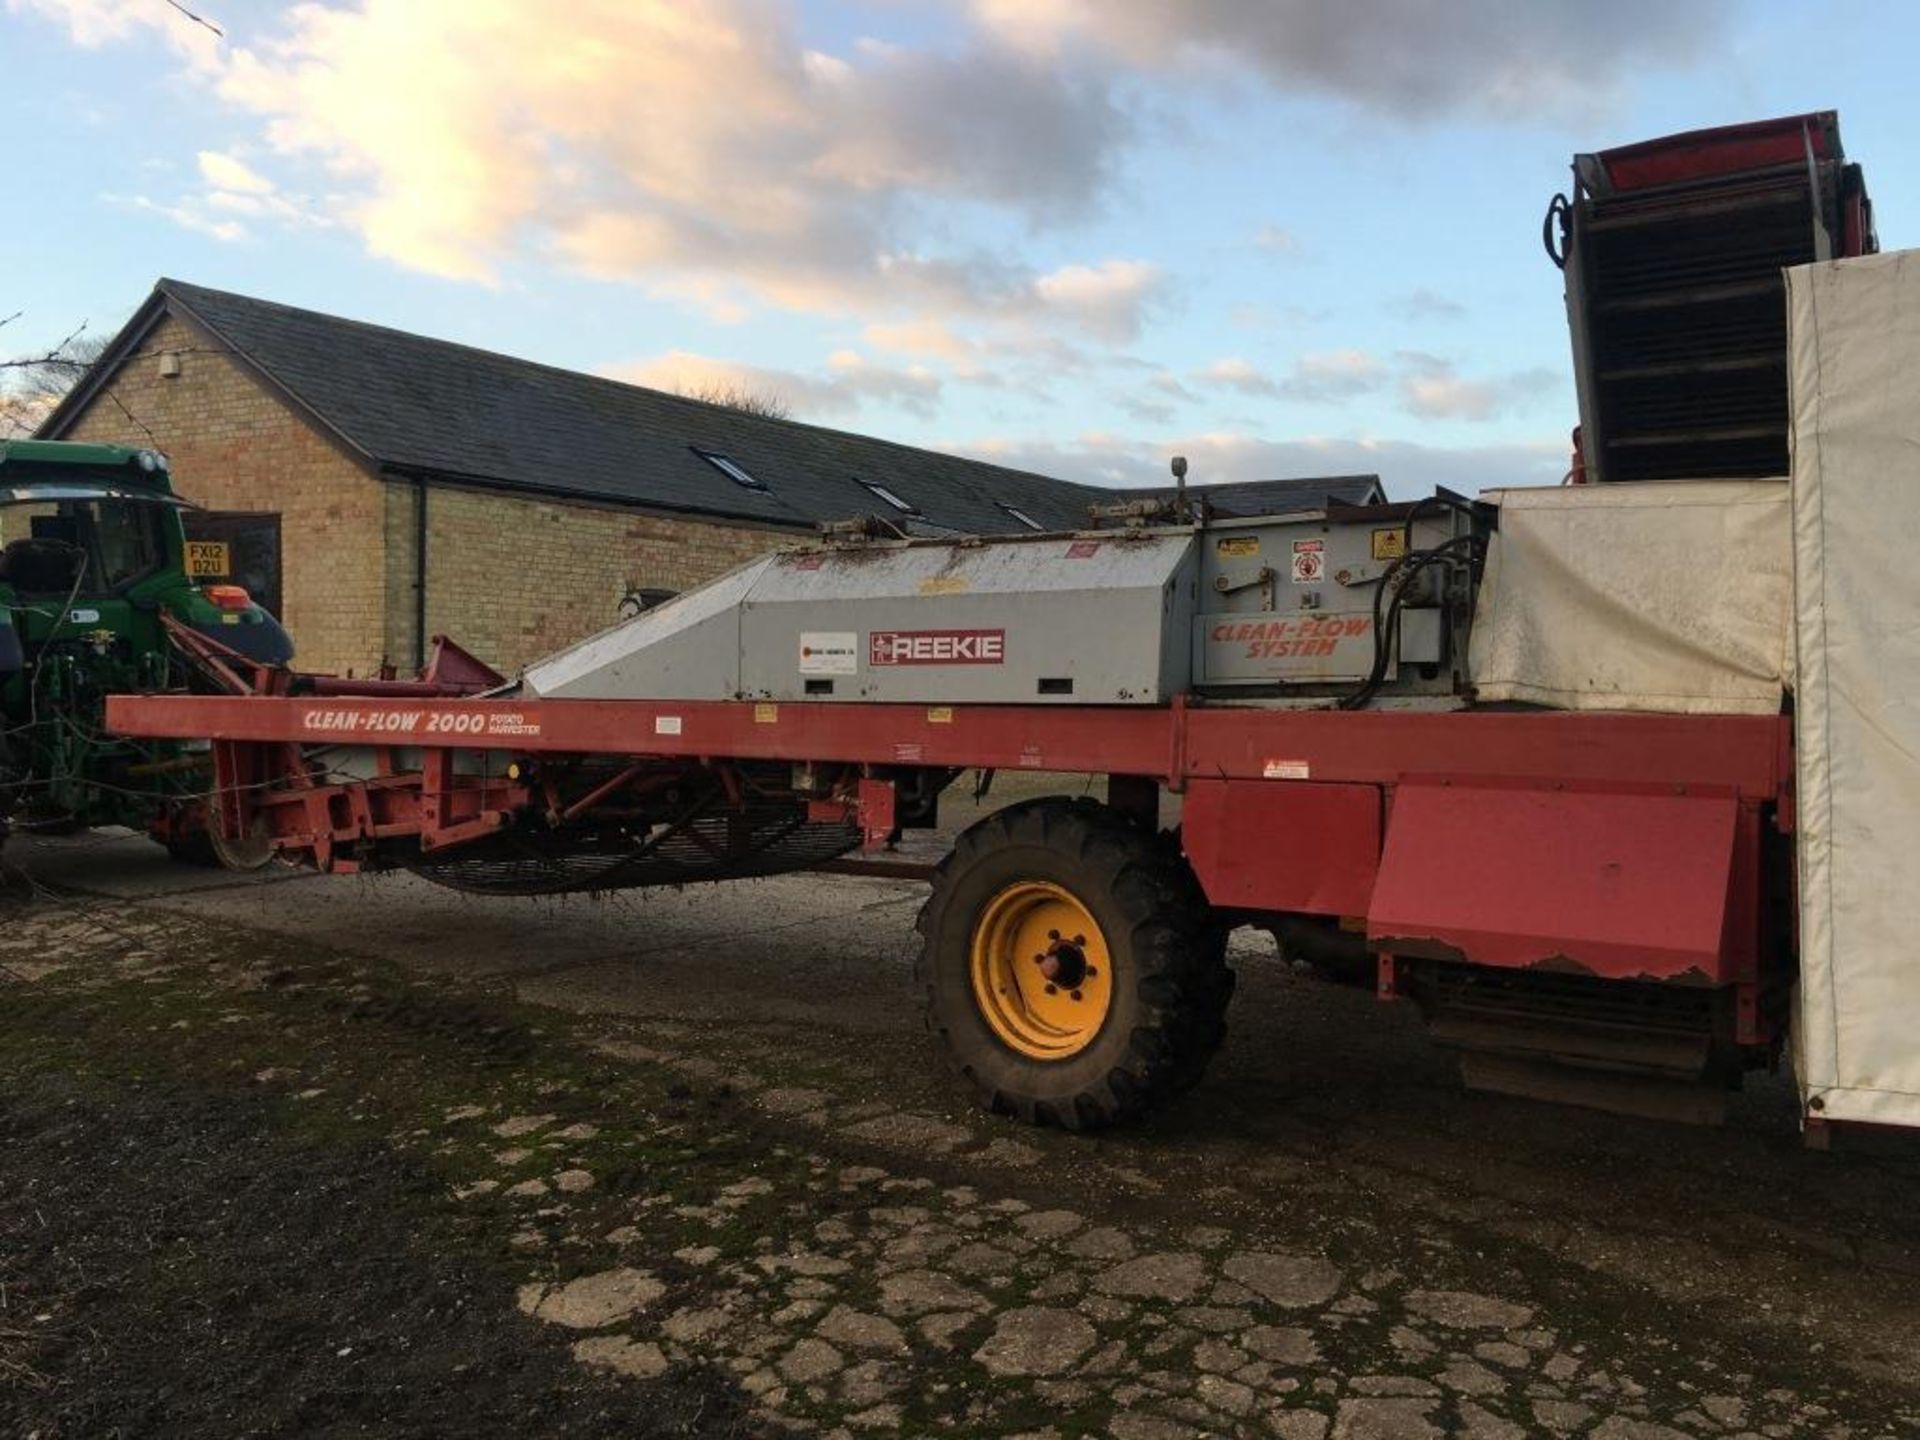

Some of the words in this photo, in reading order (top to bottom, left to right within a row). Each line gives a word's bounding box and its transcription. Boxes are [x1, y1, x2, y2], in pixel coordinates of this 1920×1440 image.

[190, 544, 222, 558] FX12
[1211, 617, 1370, 642] CLEAN-FLOW
[891, 636, 1002, 659] REEKIE
[1246, 639, 1338, 659] SYSTEM
[304, 711, 420, 731] CLEAN-FLOW
[425, 713, 484, 733] 2000
